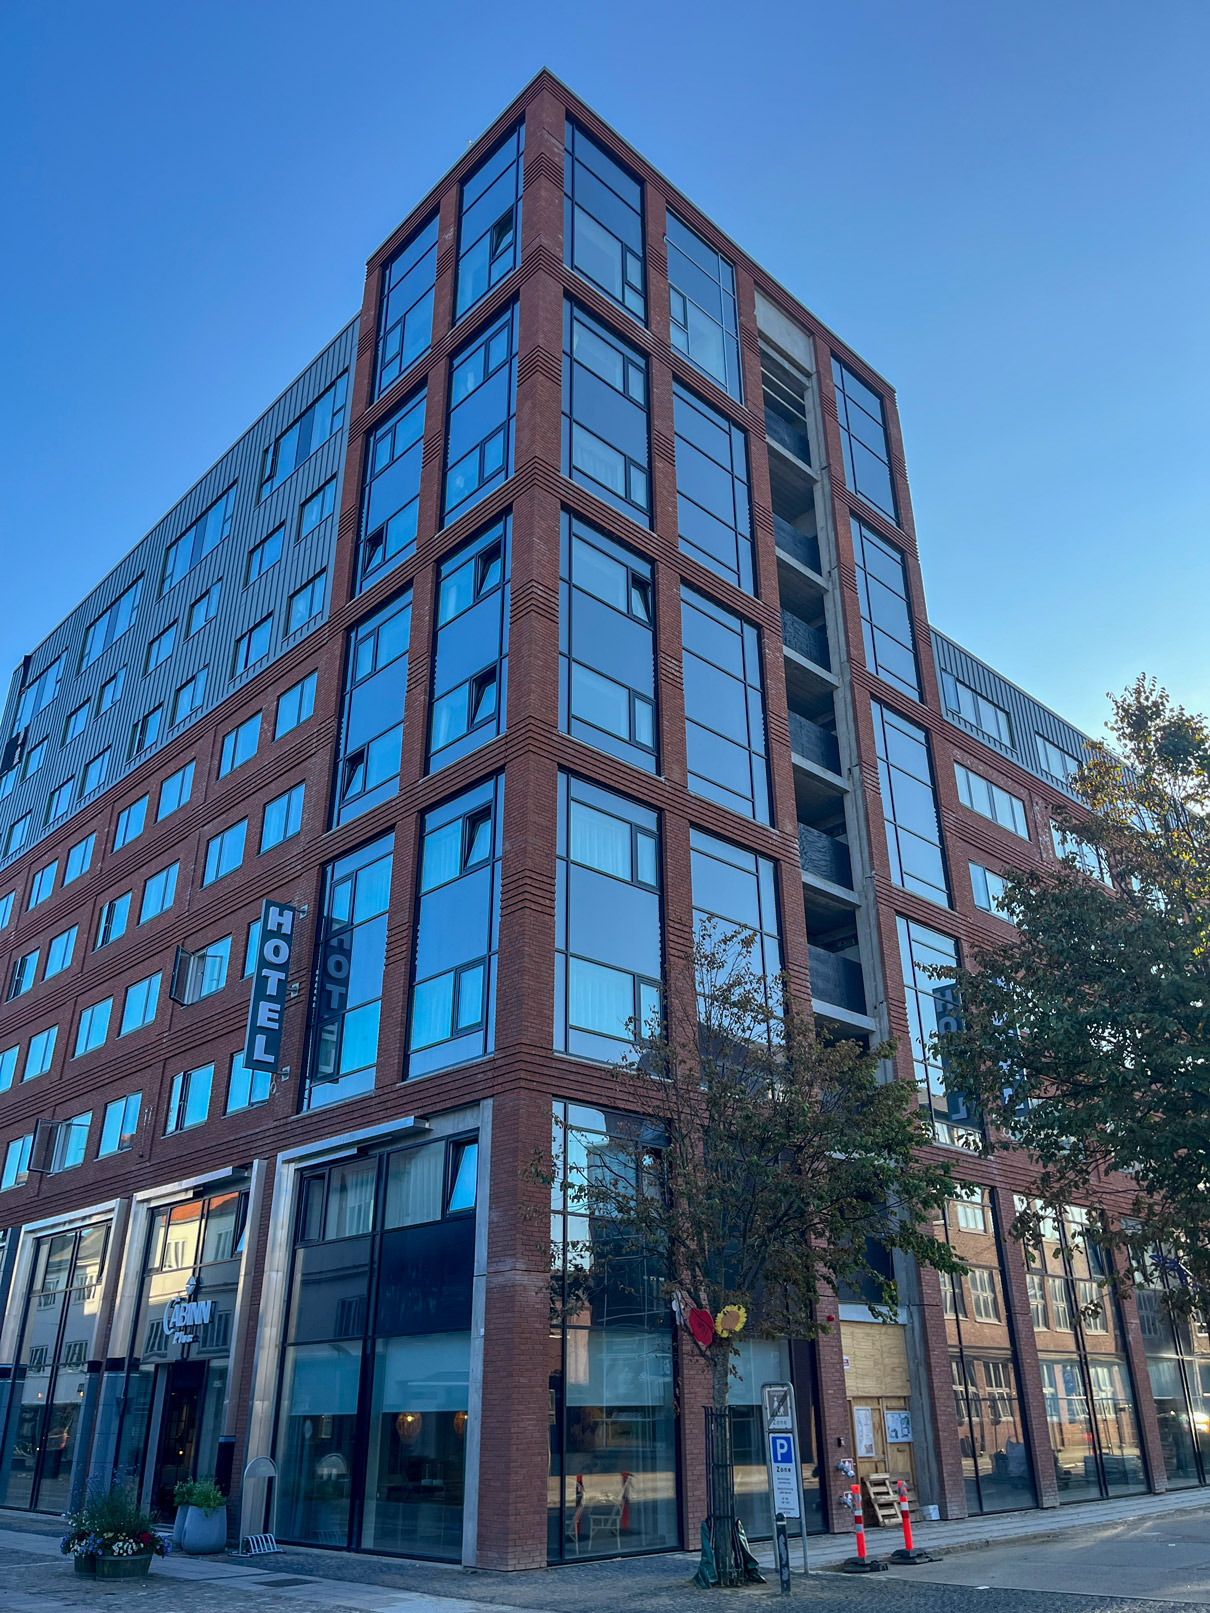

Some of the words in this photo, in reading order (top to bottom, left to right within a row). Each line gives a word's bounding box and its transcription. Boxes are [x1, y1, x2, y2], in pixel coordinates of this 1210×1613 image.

[253, 906, 293, 1063] HOTEL
[163, 1298, 211, 1335] CABINN
[172, 1331, 194, 1344] Plus
[776, 1439, 788, 1461] P
